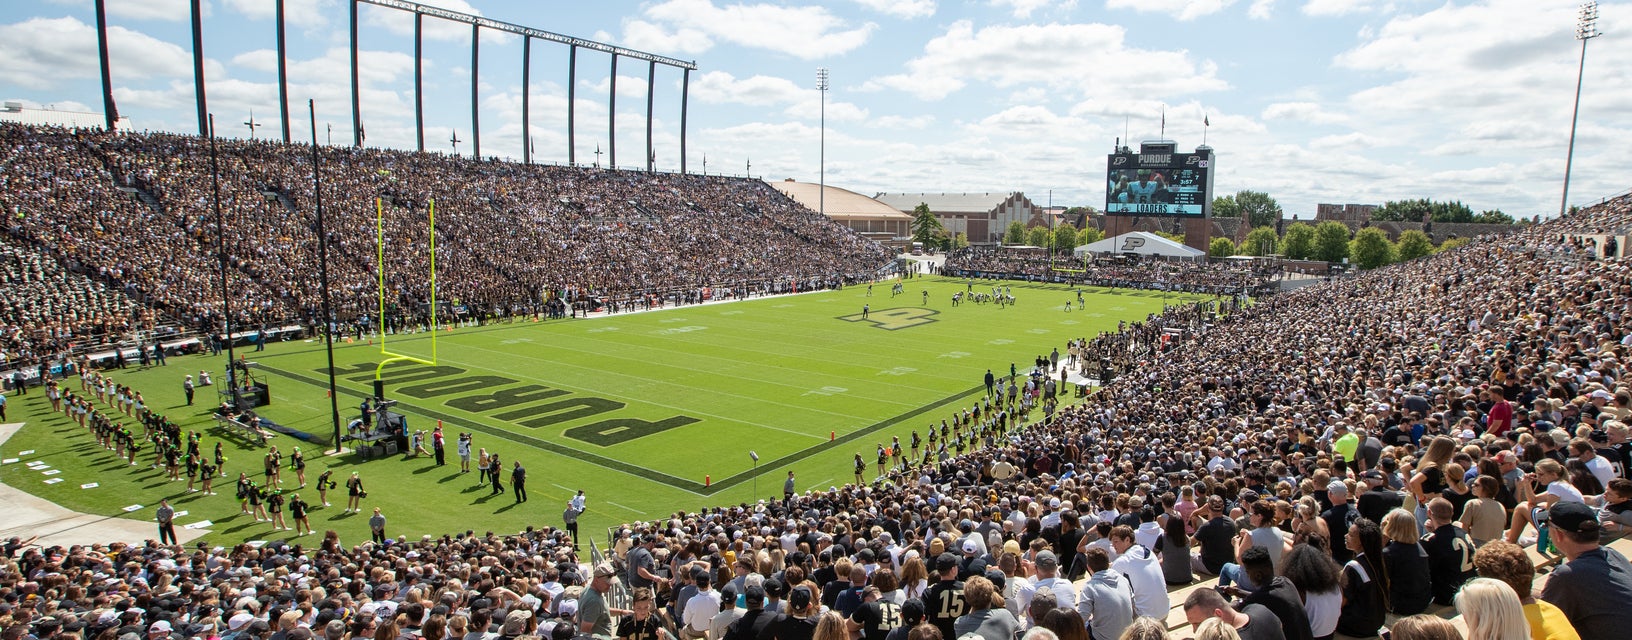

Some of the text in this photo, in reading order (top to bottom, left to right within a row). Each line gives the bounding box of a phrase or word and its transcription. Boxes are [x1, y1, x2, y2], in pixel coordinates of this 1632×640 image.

[1113, 157, 1126, 165] P
[1138, 154, 1172, 163] PURDUE
[1186, 156, 1200, 164] P
[1136, 204, 1168, 213] LOADERS
[1121, 237, 1146, 251] P
[937, 589, 965, 619] 15
[877, 602, 903, 631] 15
